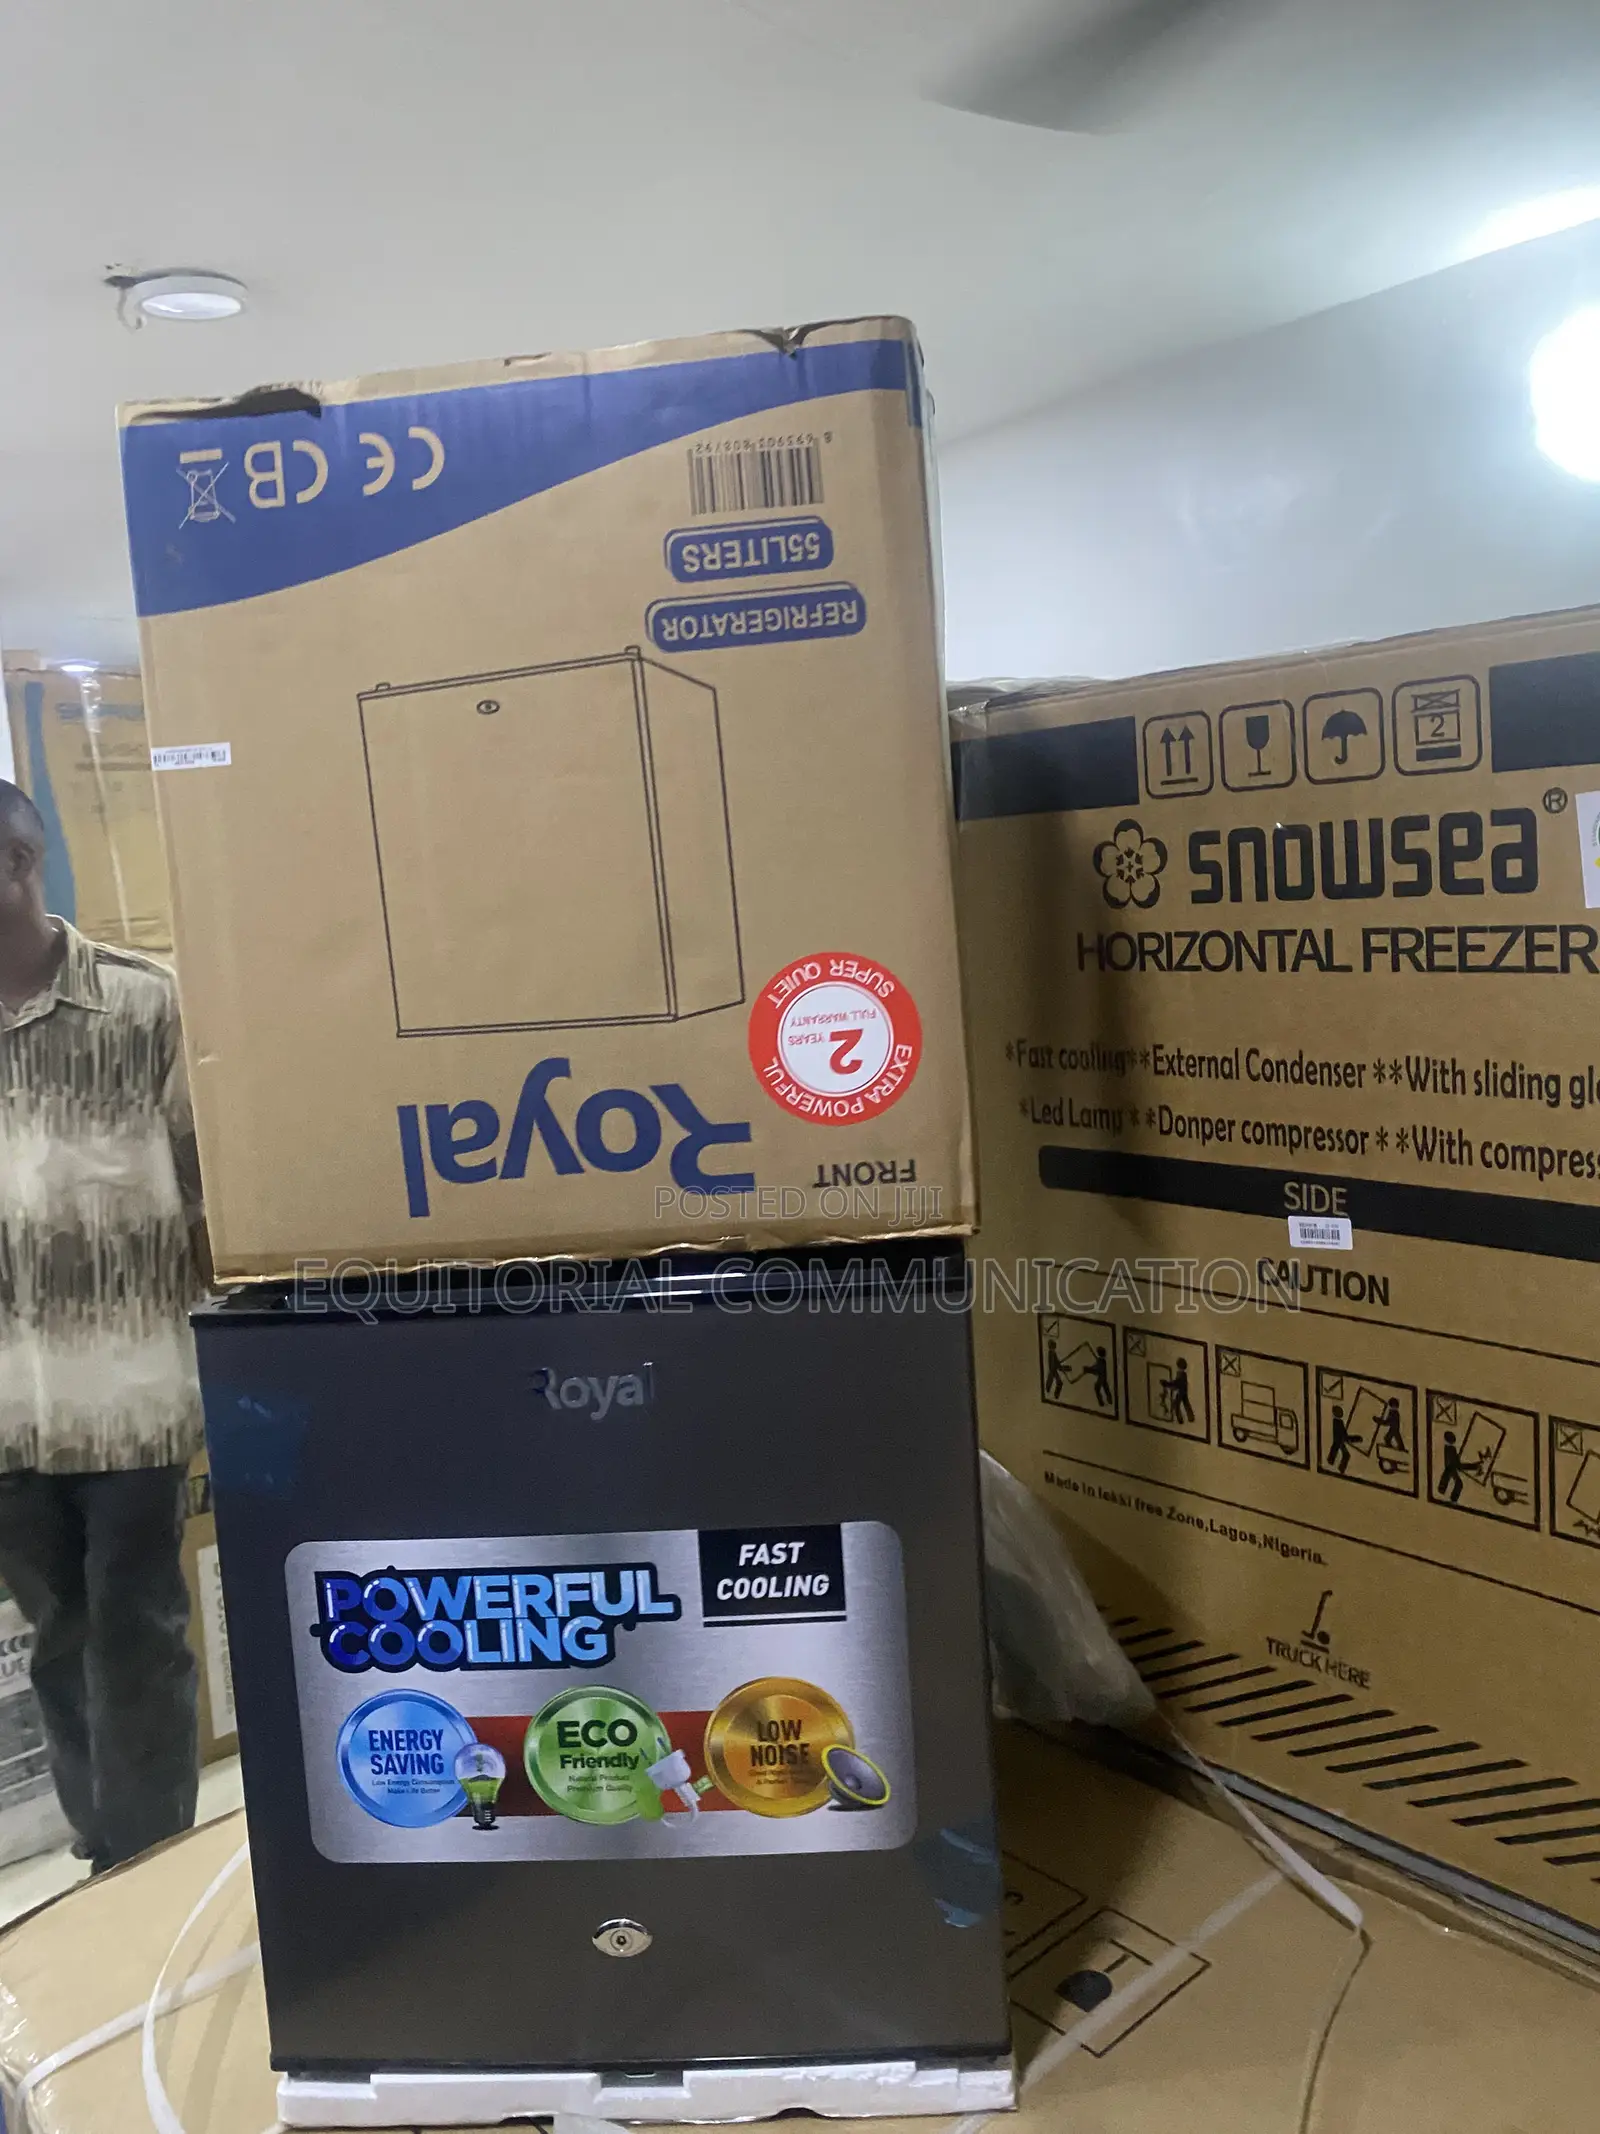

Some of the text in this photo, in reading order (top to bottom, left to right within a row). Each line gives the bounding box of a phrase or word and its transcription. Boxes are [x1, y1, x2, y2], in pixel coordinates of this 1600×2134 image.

[244, 439, 329, 510] CB
[682, 532, 822, 574] 55LITERS
[661, 599, 859, 642] REFRIGERATOR
[1076, 923, 1600, 975] HORIZONTAL FREEZER
[766, 958, 896, 1010] SUPER QUIET
[849, 1007, 878, 1021] FULL
[787, 1028, 865, 1076] 2 YEARS
[762, 1043, 914, 1119] EXTRA POWERFUL
[1245, 1047, 1367, 1089] Condenser
[1473, 1058, 1561, 1109] sliding
[396, 1056, 756, 1219] Royal
[1240, 1118, 1370, 1156] compressor
[1480, 1140, 1600, 1183] compres
[811, 1158, 917, 1189] FRONT
[1283, 1180, 1350, 1217] SIDE
[1257, 1256, 1391, 1308] CAUTION
[738, 1541, 806, 1567] FAST
[322, 1569, 675, 1621] POWERFUL
[716, 1573, 830, 1601] COOLING
[328, 1615, 608, 1667] COOLING
[1265, 1636, 1372, 1691] TRUCK HERE
[368, 1728, 444, 1752] ENERGY
[556, 1718, 638, 1749] ECO
[756, 1718, 803, 1742] LOW
[370, 1752, 445, 1776] SAVING
[559, 1753, 640, 1771] Friendly
[750, 1742, 811, 1767] NOISE
